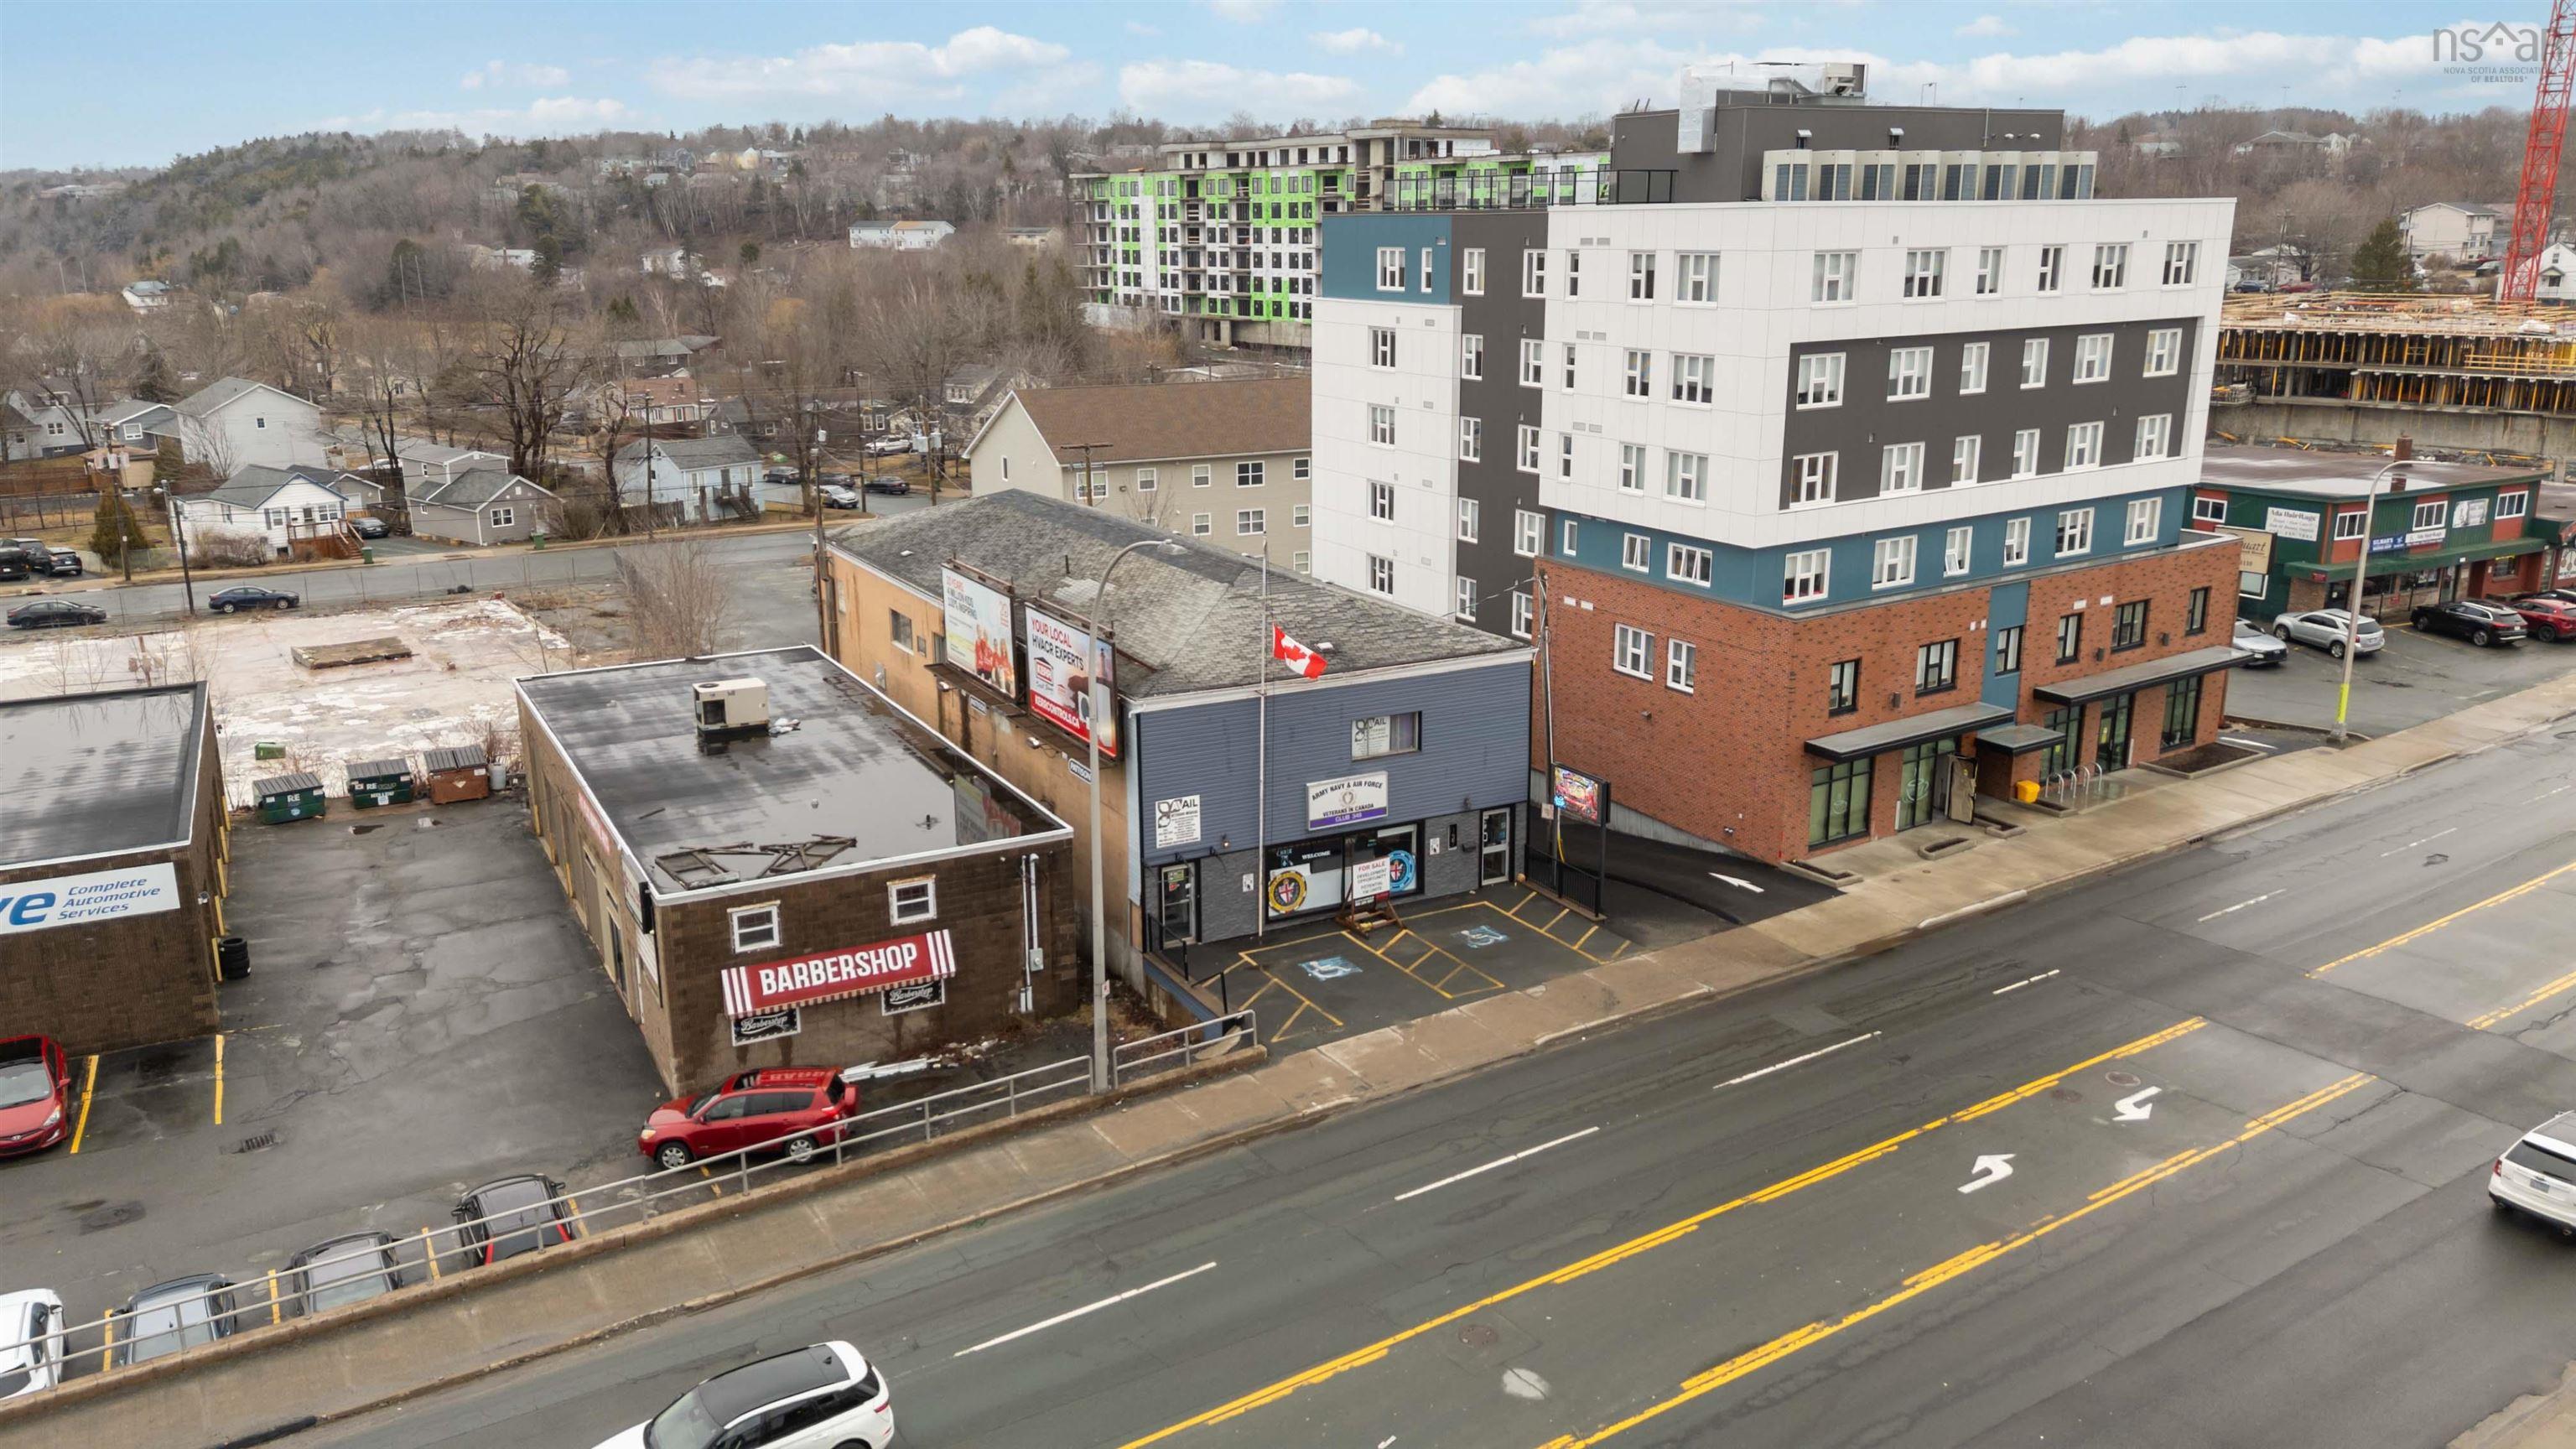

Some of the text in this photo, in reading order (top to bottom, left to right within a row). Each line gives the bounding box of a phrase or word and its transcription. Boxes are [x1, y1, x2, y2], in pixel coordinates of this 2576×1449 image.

[1031, 617, 1072, 648] YOUR LOCAL
[1055, 644, 1084, 672] EXPERTS
[1311, 789, 1328, 801] ARMY
[1330, 783, 1345, 792] NAVY
[1364, 780, 1383, 789] FORCE
[1322, 808, 1348, 817] VETERANS
[1354, 802, 1374, 812] CANADA
[1371, 860, 1385, 870] SALE
[68, 878, 147, 896] Complete
[63, 887, 161, 907] Automotive
[57, 903, 129, 921] Services
[759, 943, 917, 996] BARBERSHOP
[890, 984, 933, 1003] Barbershop
[740, 1015, 788, 1032] Barbershop
